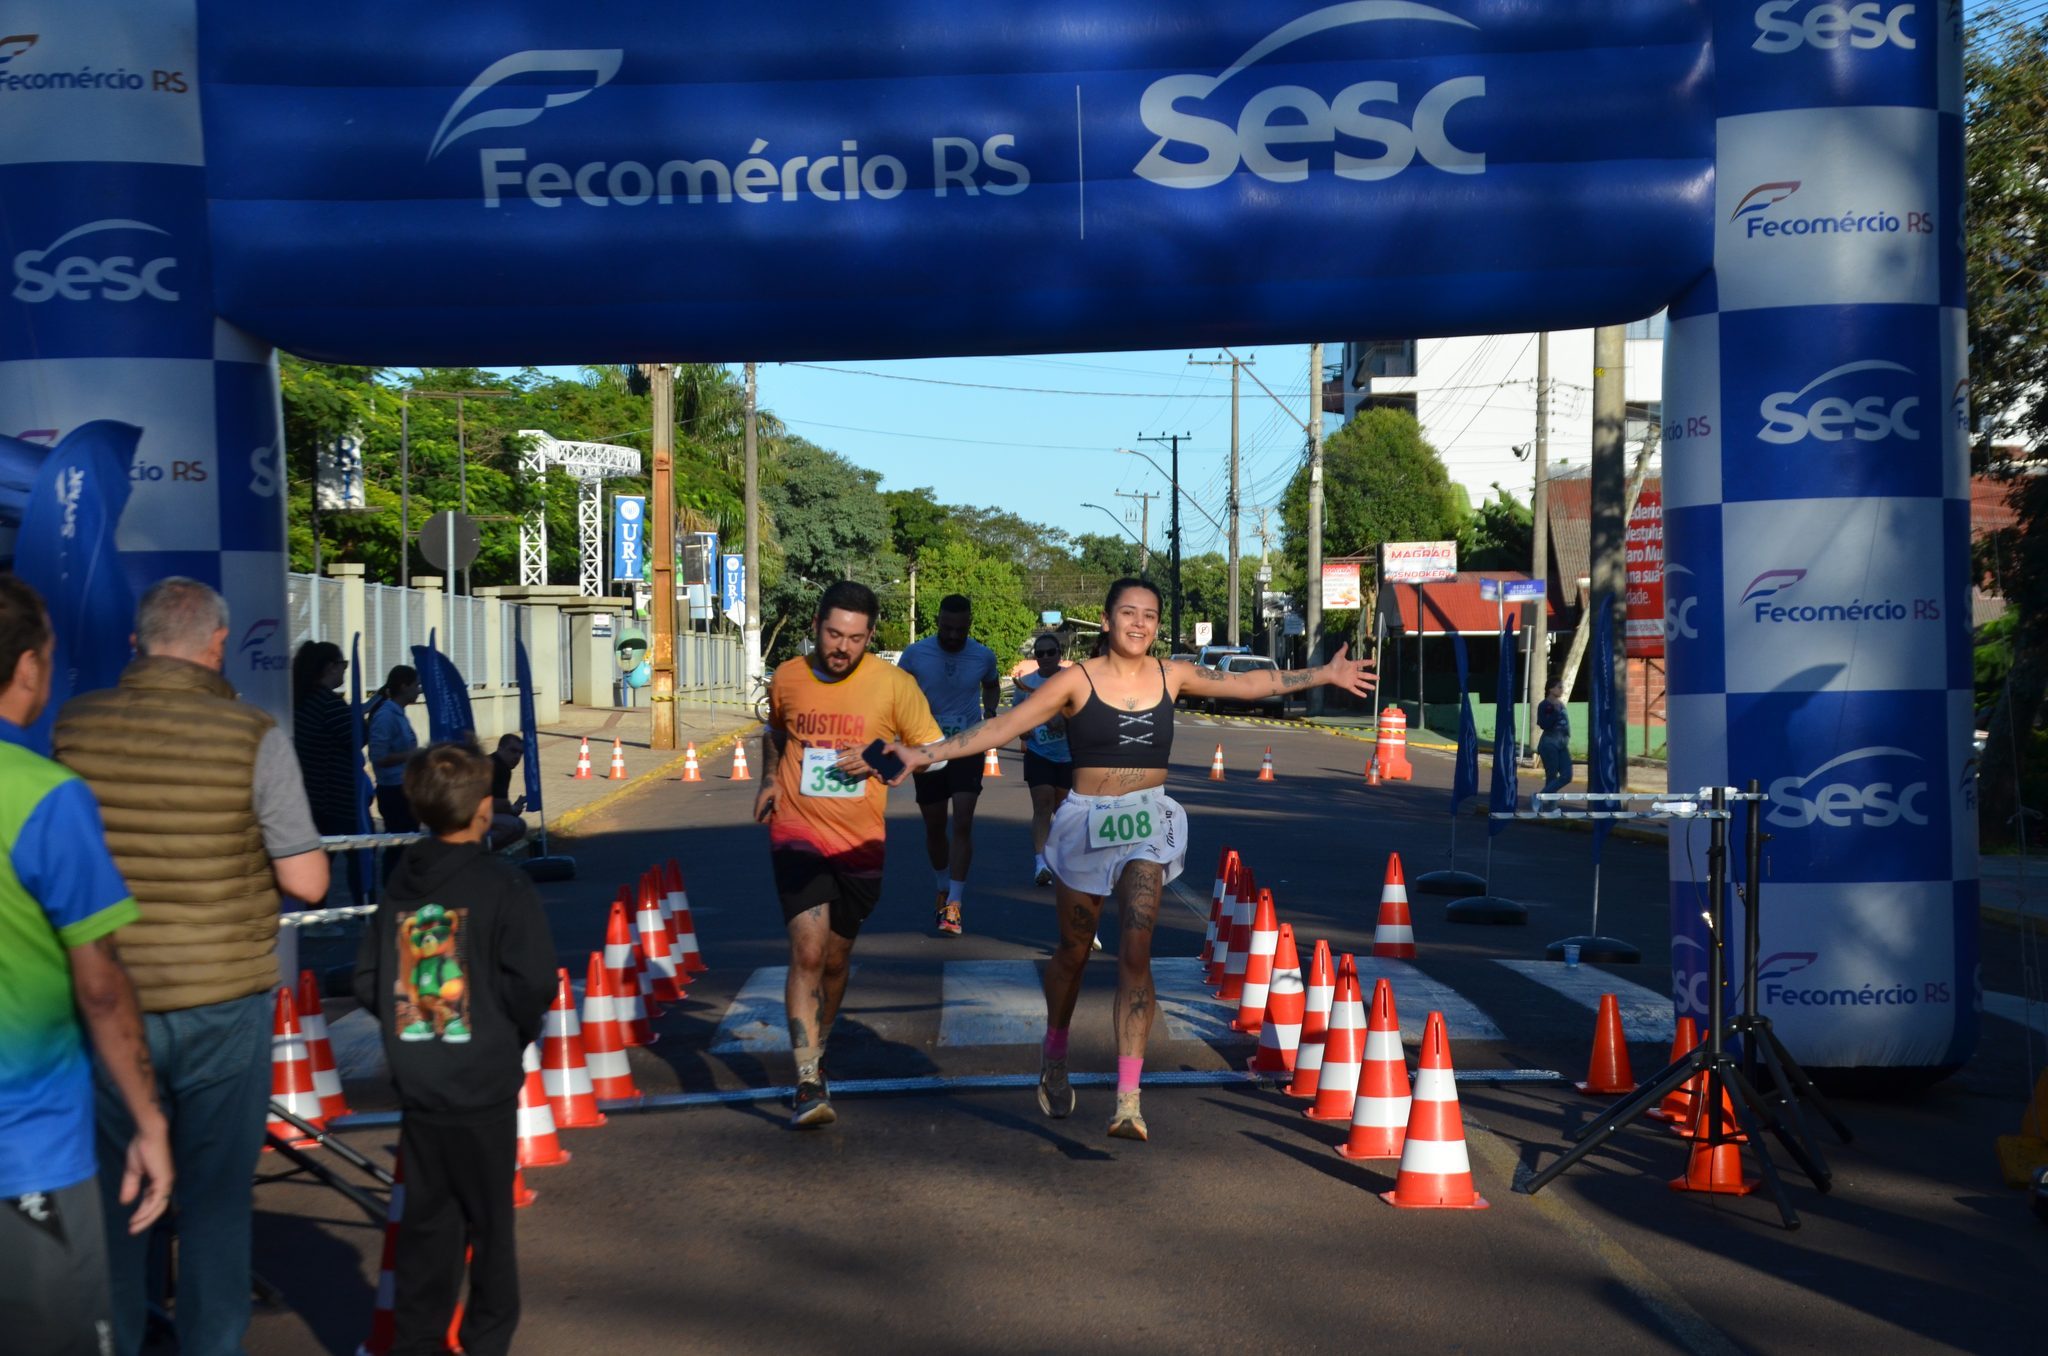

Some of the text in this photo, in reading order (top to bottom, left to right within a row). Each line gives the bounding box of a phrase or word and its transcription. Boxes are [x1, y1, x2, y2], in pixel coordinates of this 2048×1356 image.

[1751, 0, 1917, 54] Sesc
[152, 70, 188, 93] RS
[1132, 74, 1486, 189] Sesc
[479, 134, 1031, 209] Fecomércio RS
[1747, 211, 1934, 239] Fecomércio RS
[12, 249, 180, 302] Sesc
[1686, 416, 1711, 438] RS
[1757, 391, 1920, 445] Sesc
[172, 461, 208, 482] RS
[622, 523, 638, 577] URI
[1755, 597, 1940, 623] Fecomércio RS
[796, 709, 865, 737] RÚSTICA
[1765, 776, 1929, 828] Sesc
[1099, 810, 1152, 842] 408
[1767, 978, 1950, 1006] Fecomércio RS
